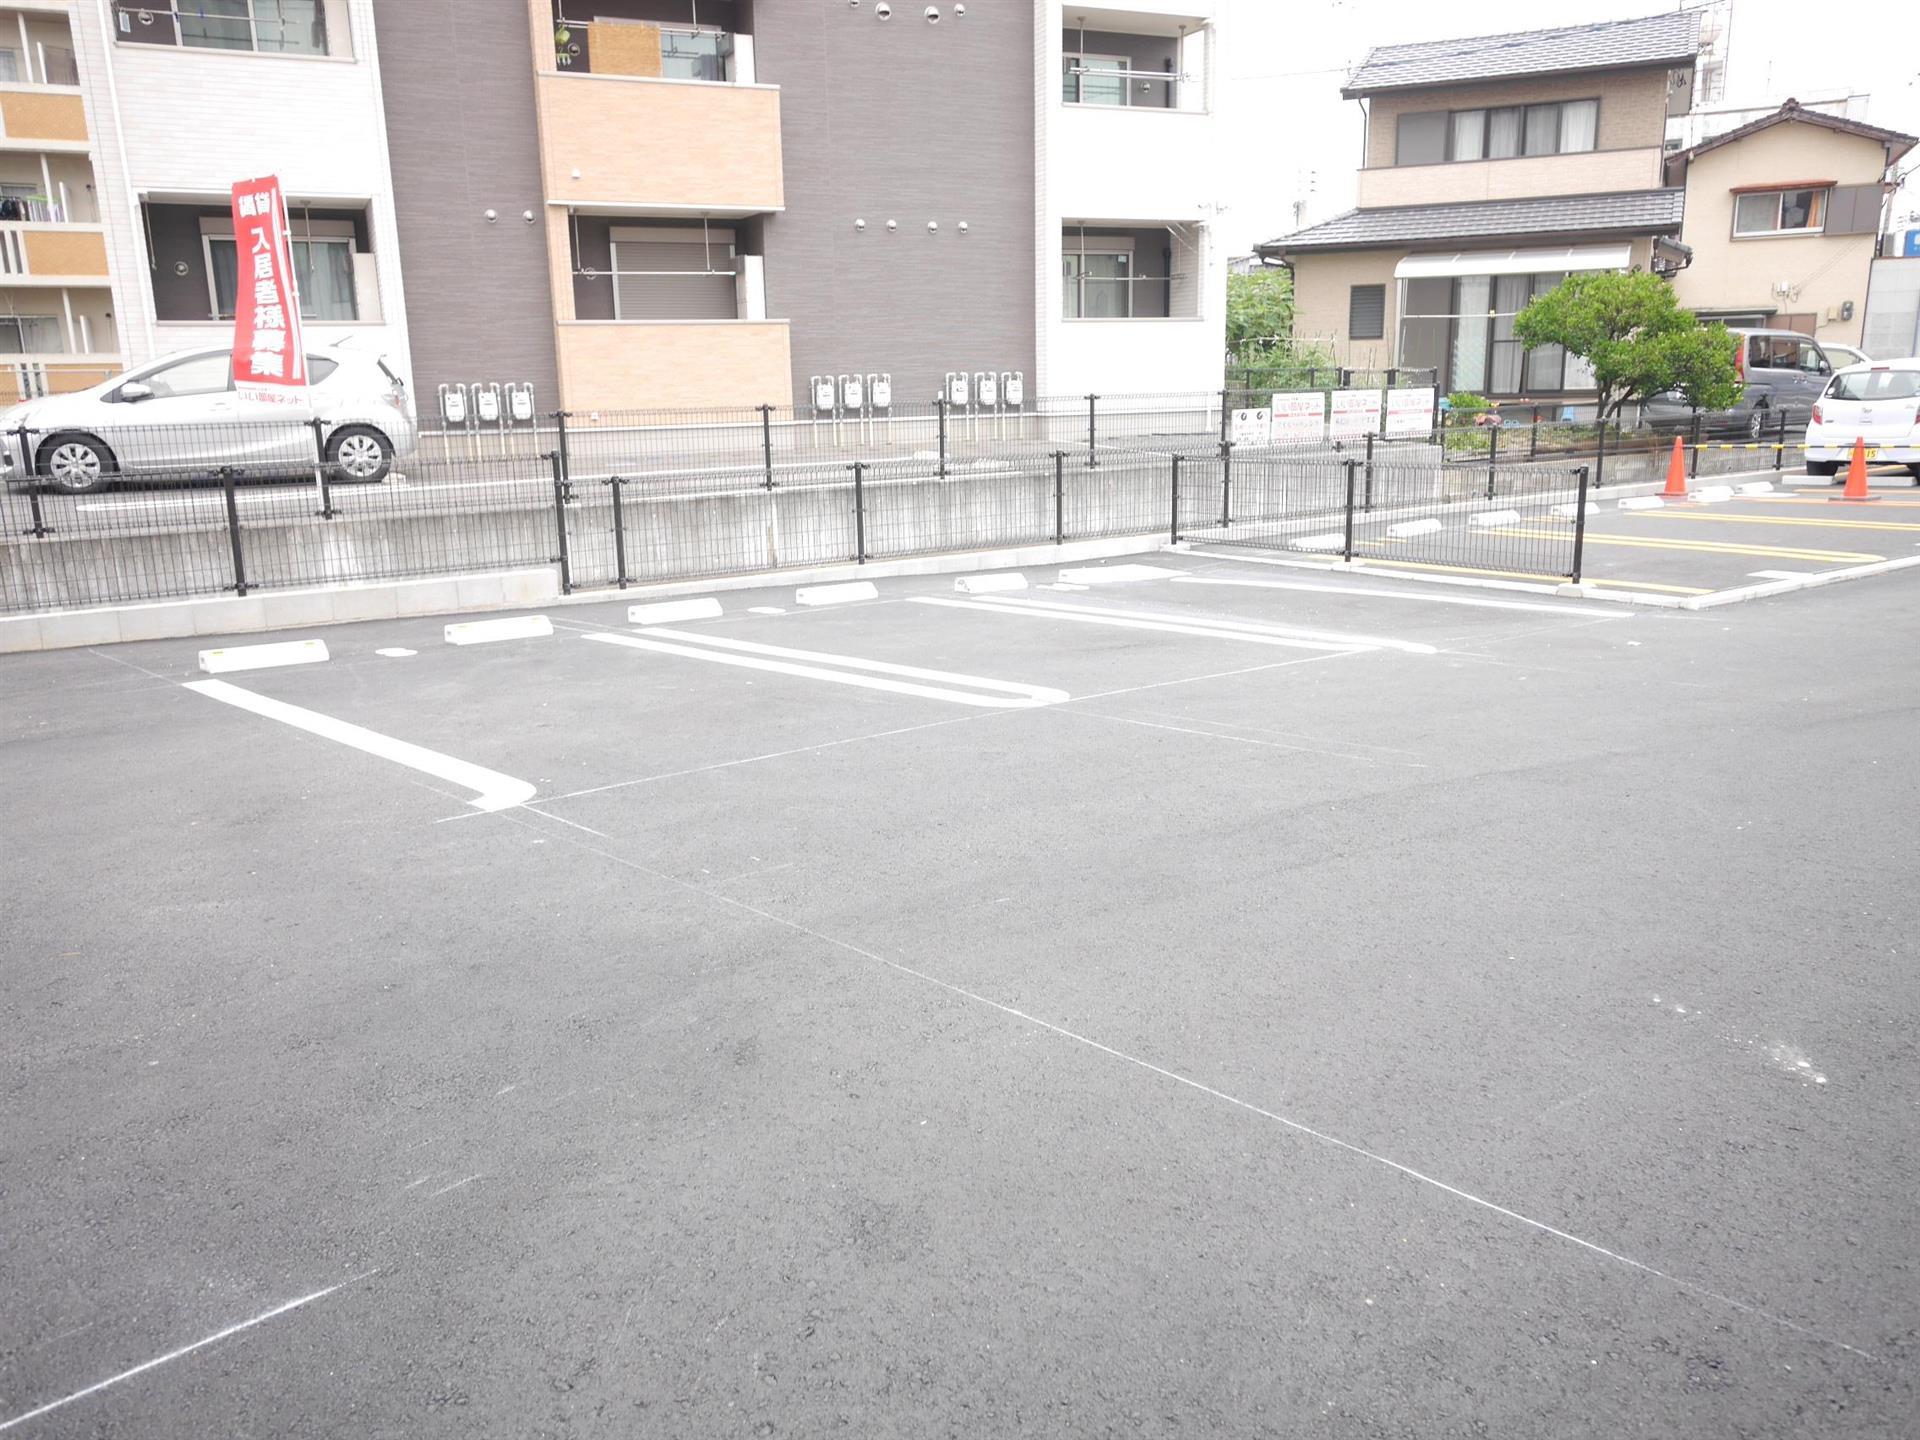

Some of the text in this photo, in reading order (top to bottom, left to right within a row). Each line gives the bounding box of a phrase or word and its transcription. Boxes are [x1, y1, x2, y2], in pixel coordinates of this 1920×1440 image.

[250, 226, 287, 378] 入居者様募集
